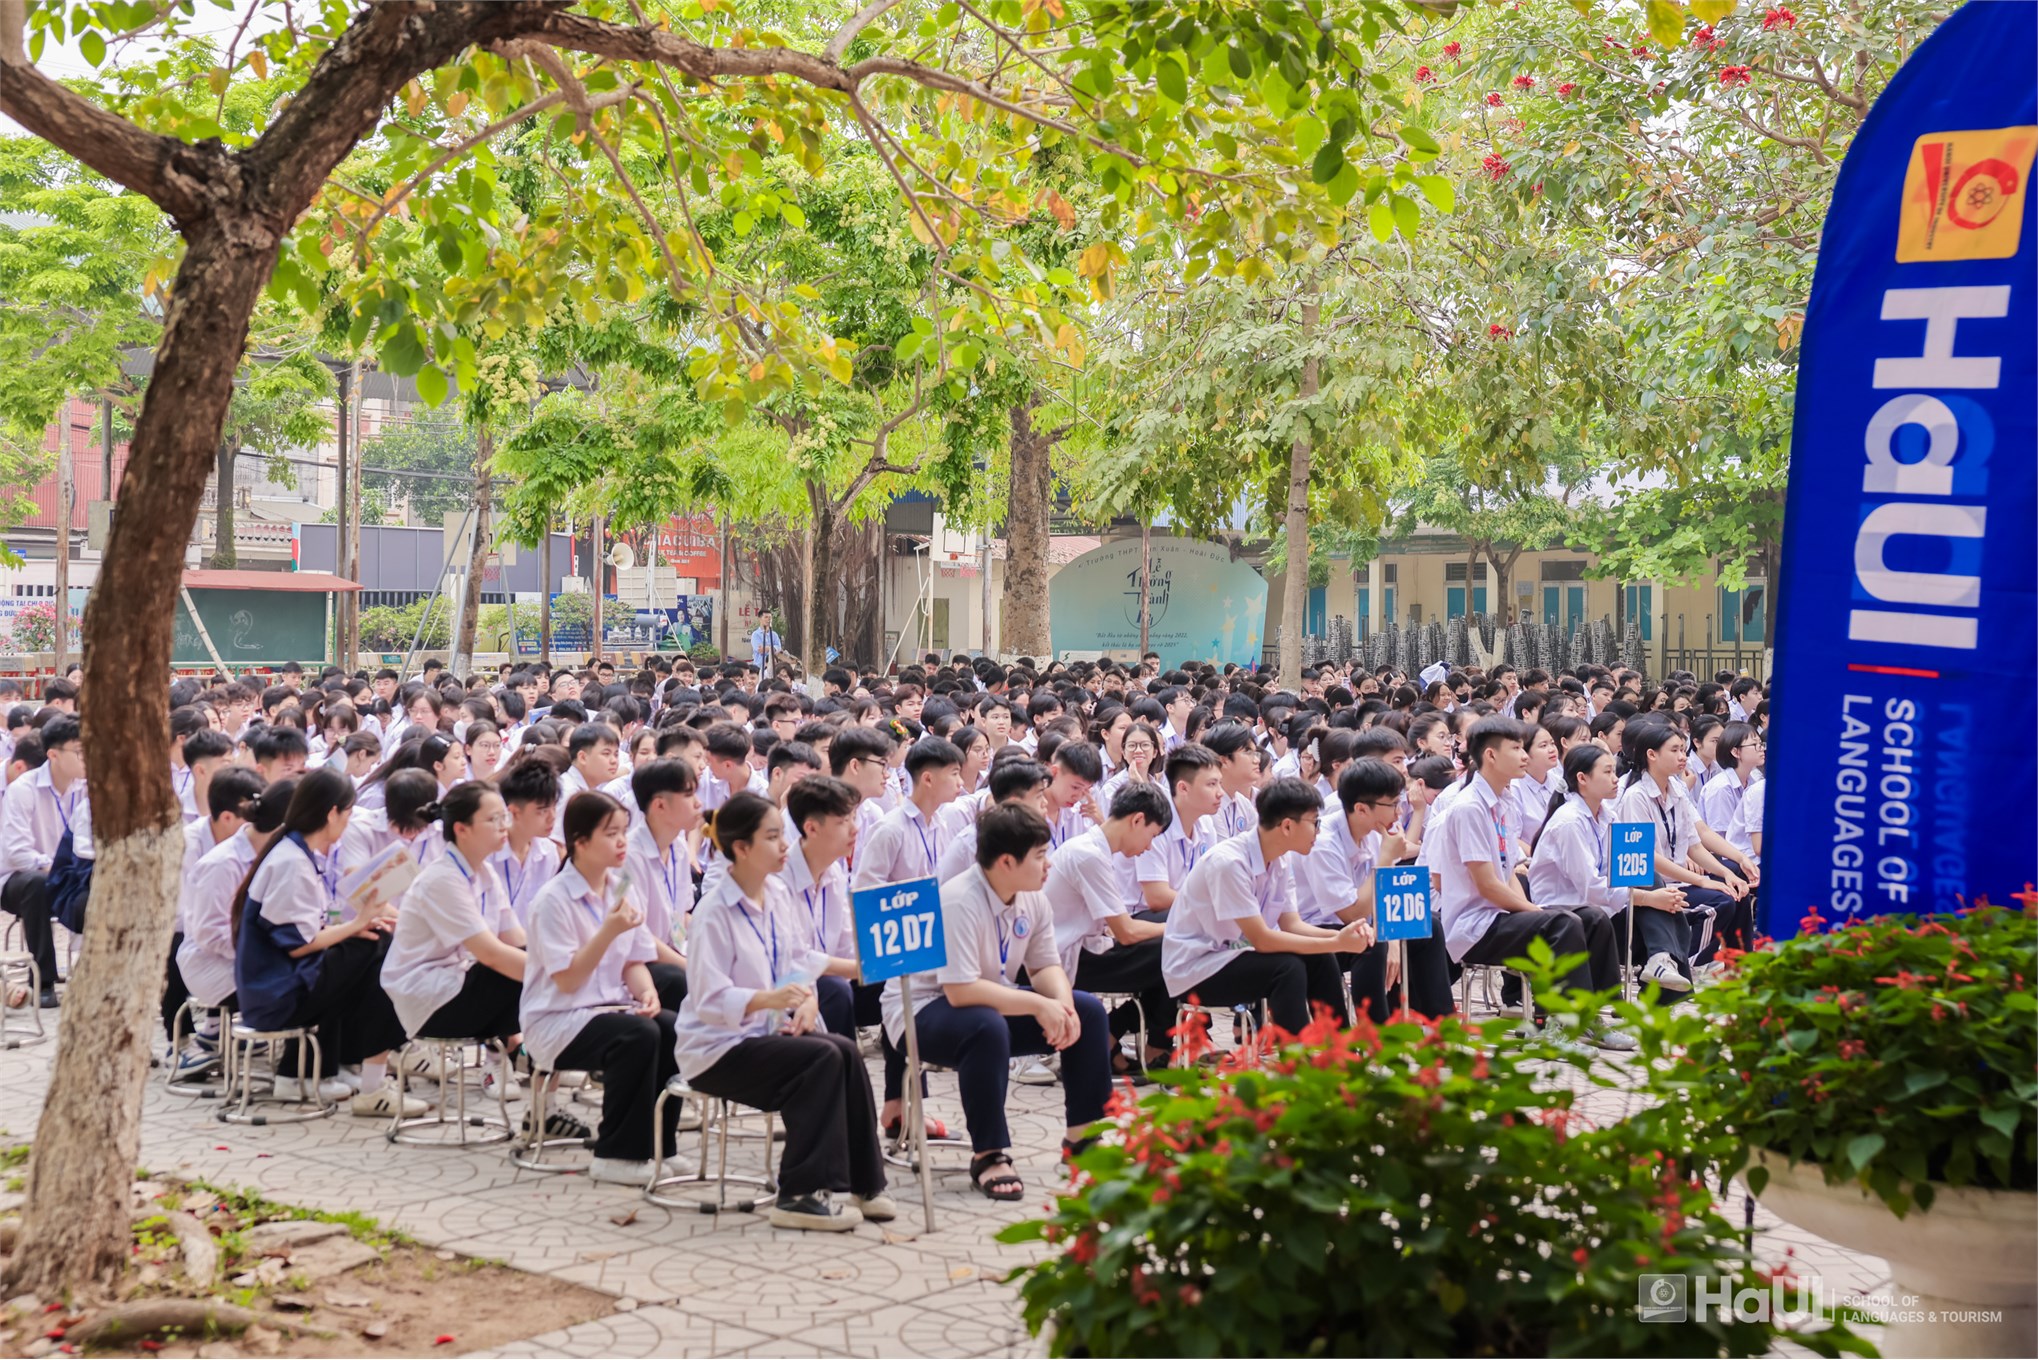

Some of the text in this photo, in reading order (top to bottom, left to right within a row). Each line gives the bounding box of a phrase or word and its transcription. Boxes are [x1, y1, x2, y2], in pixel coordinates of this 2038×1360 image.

[1848, 284, 2012, 650] HaUI
[1118, 547, 1138, 556] THPT
[1830, 693, 1873, 913] LANGUAGES
[1877, 697, 1916, 903] SCHOOL OF
[1624, 827, 1643, 843] LỚP
[1617, 852, 1647, 876] 12D5
[1392, 871, 1417, 886] LỚP
[880, 890, 919, 912] LỚP
